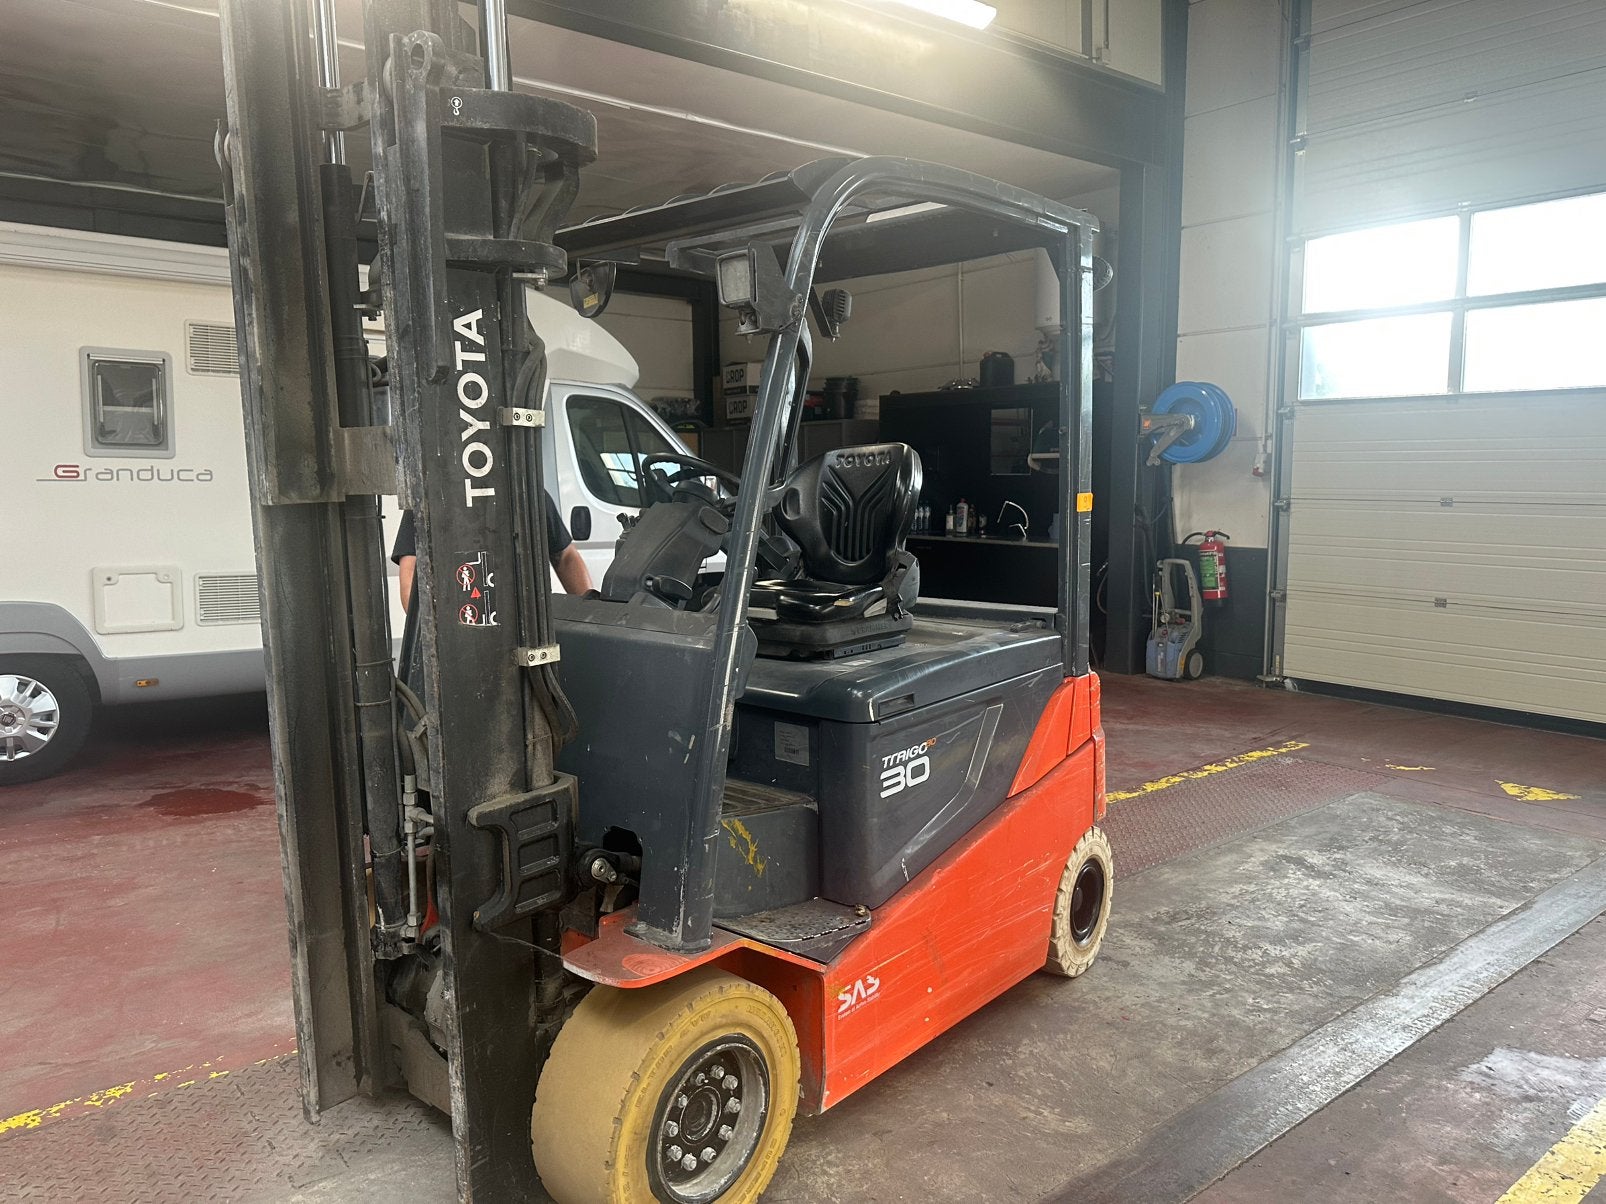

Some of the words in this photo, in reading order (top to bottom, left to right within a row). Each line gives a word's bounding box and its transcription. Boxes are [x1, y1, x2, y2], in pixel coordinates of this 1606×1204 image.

[453, 308, 496, 508] TOYOTA
[52, 464, 213, 482] Granduca
[835, 450, 892, 469] TOYOTA
[880, 755, 930, 799] 30
[837, 975, 880, 1014] SAS
